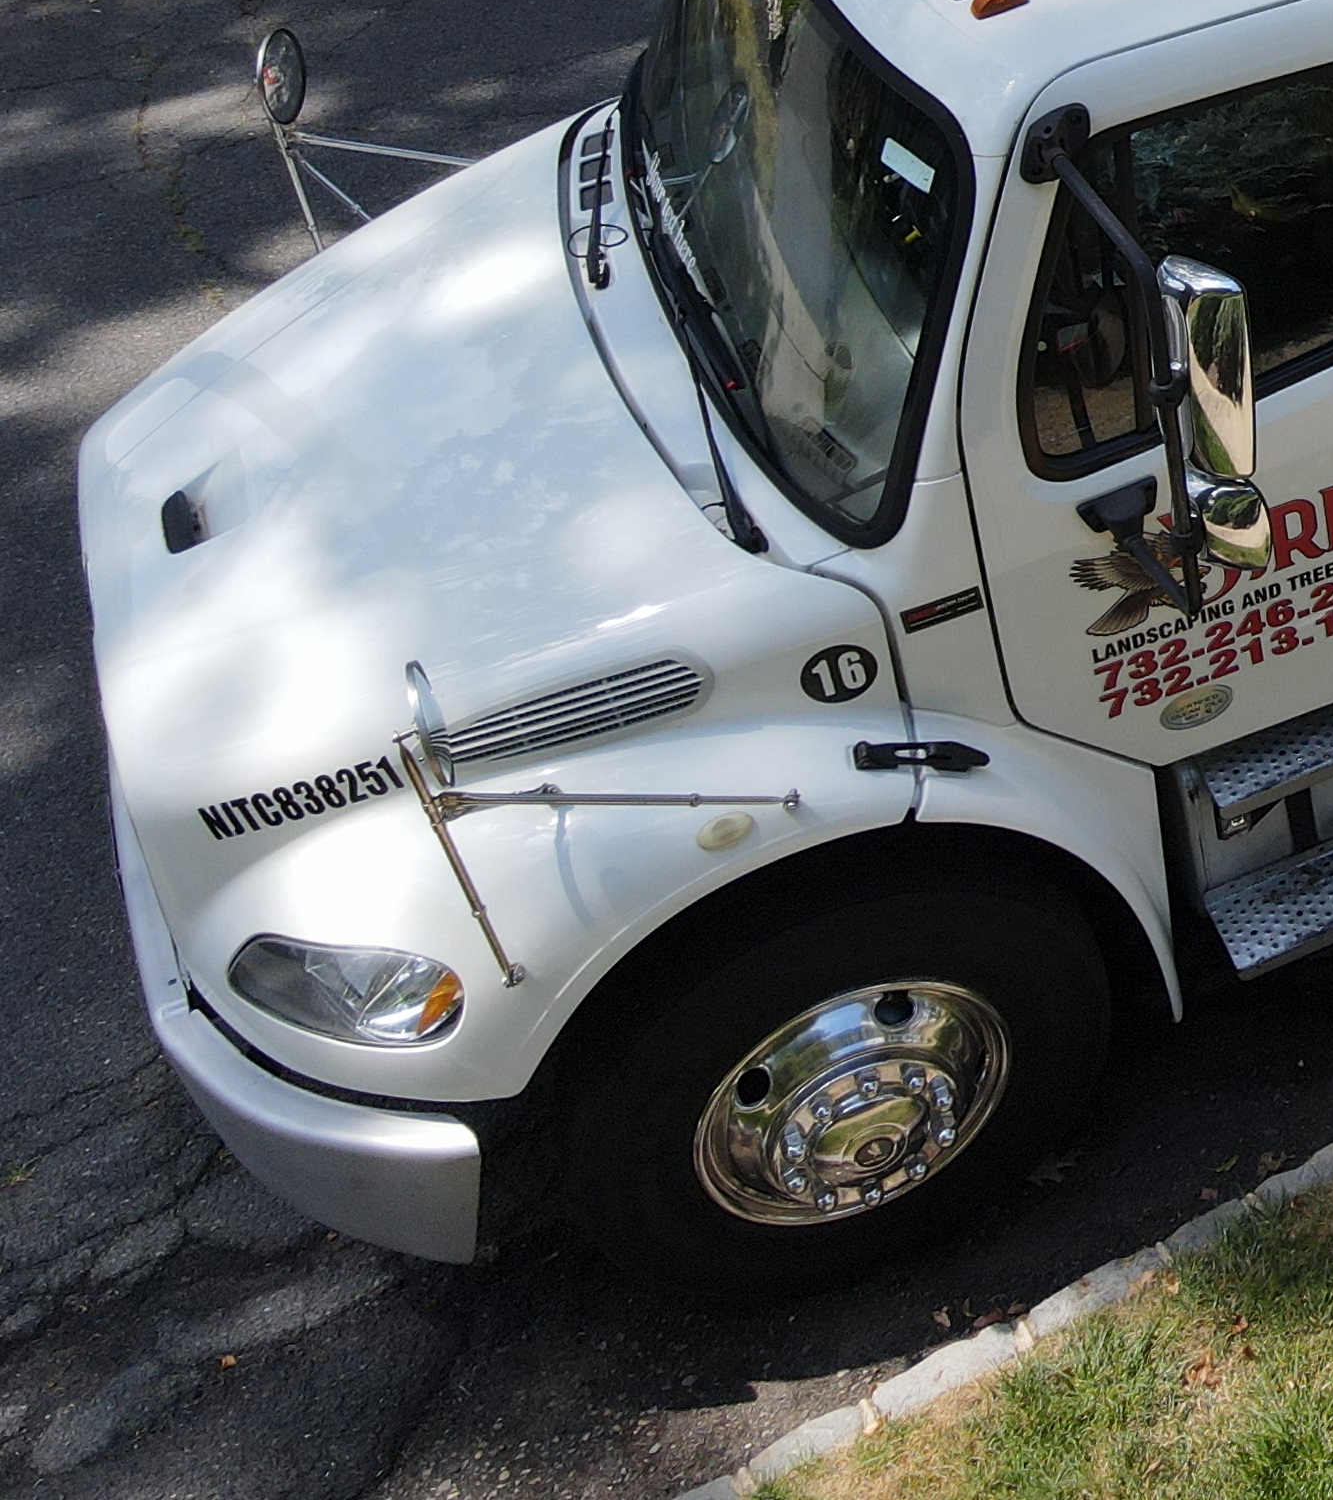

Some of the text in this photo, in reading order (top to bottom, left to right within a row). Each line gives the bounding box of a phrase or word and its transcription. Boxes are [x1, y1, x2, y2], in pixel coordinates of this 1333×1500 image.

[1092, 599, 1235, 664] LANDSCAPING
[1241, 582, 1282, 610] AND
[811, 650, 868, 698] 16
[197, 755, 405, 841] NJTC838251
